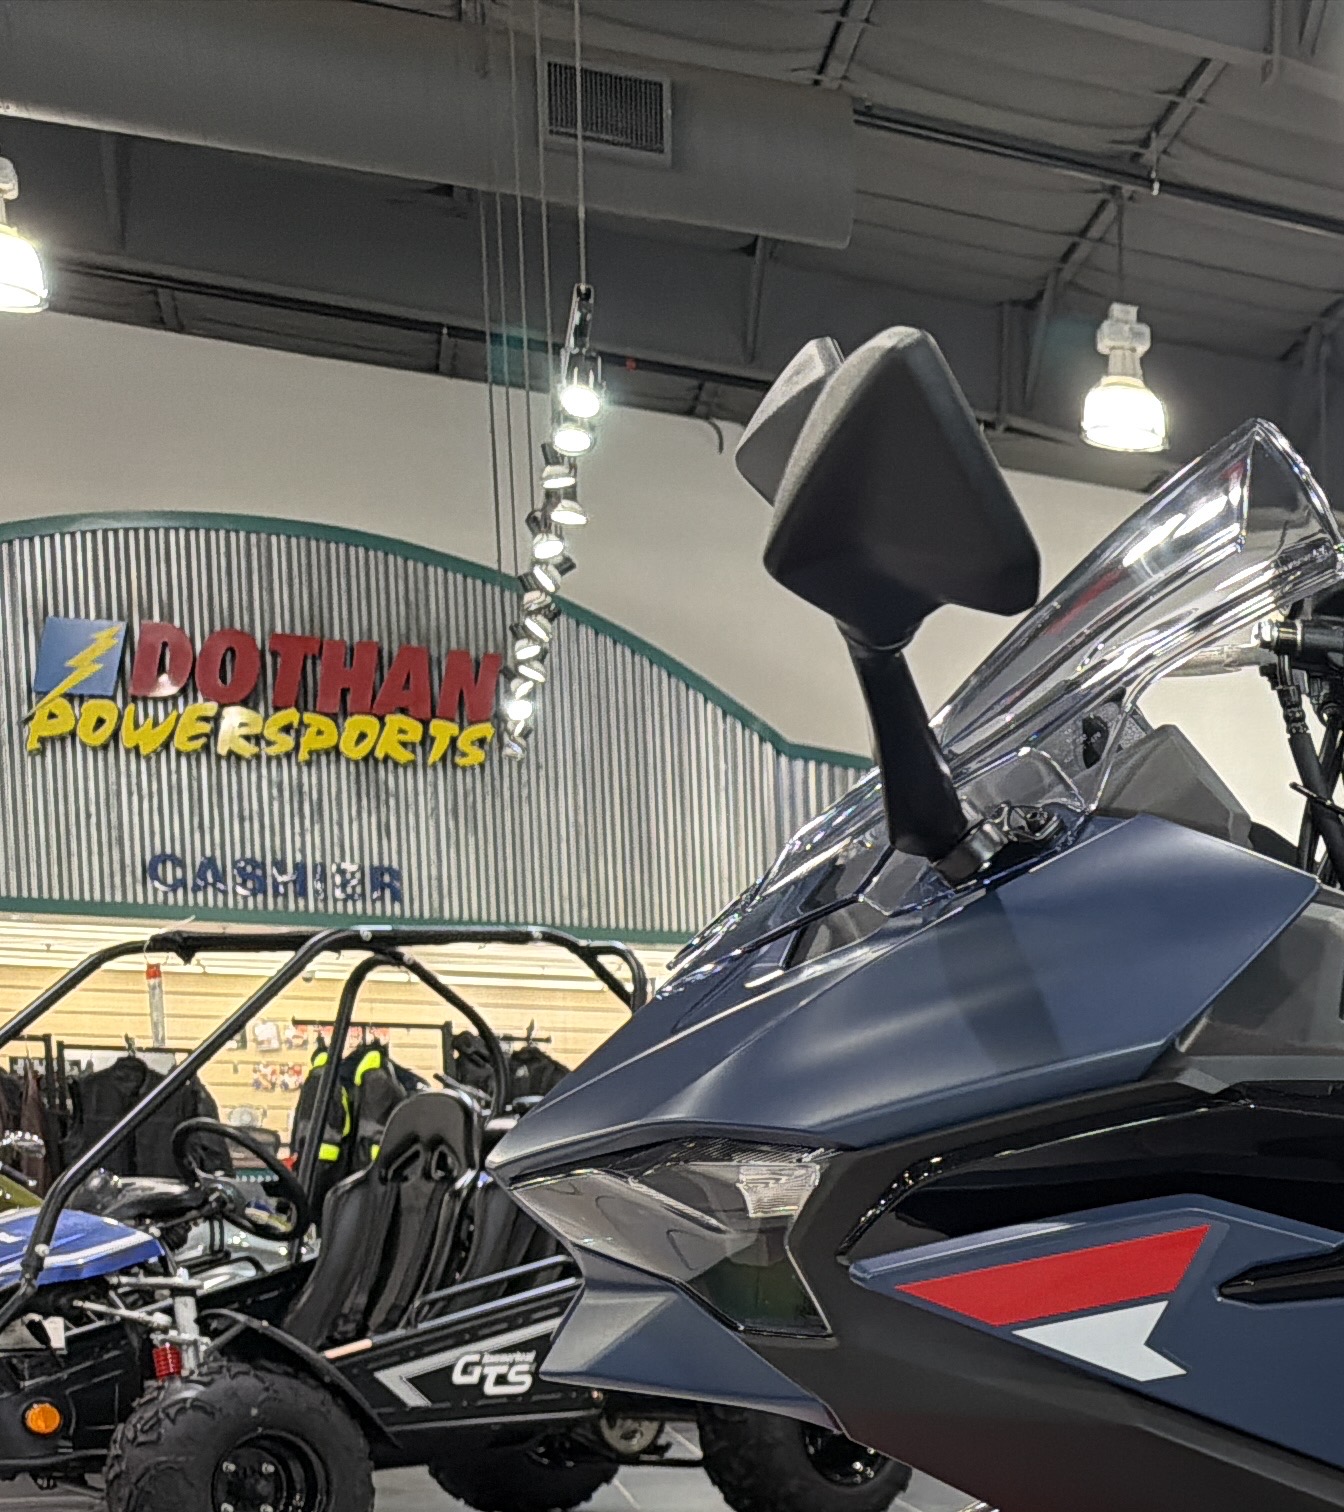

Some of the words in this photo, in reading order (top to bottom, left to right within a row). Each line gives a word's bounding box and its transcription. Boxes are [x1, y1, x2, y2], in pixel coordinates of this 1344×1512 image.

[129, 620, 502, 722] DOTHAN
[25, 697, 496, 768] POWERSPORTS
[147, 852, 402, 905] CASHIER
[452, 1353, 533, 1396] GTS
